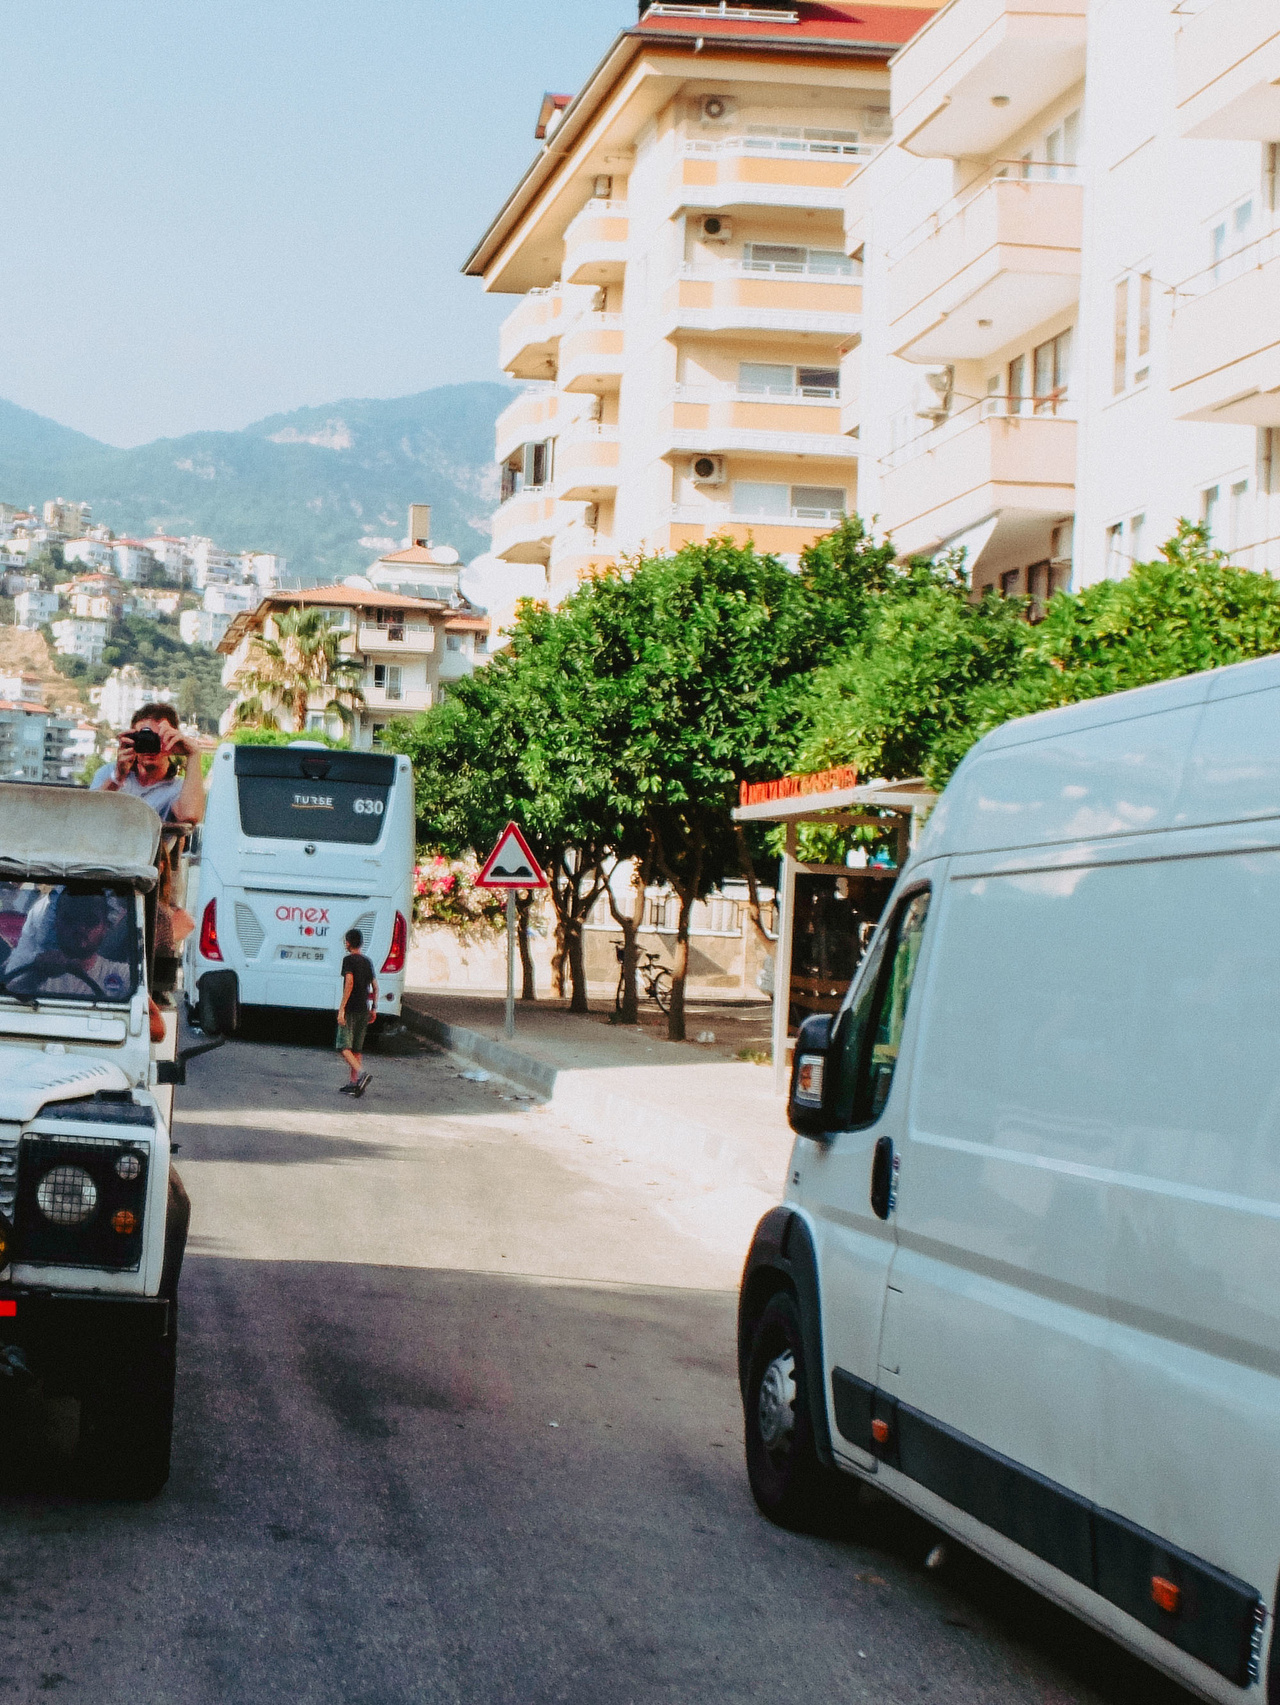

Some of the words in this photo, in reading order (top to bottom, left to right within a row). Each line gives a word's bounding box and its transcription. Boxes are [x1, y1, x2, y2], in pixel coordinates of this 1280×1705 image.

[294, 794, 333, 806] TURSE
[353, 798, 384, 815] 630
[275, 905, 330, 924] anex
[298, 924, 330, 937] tour
